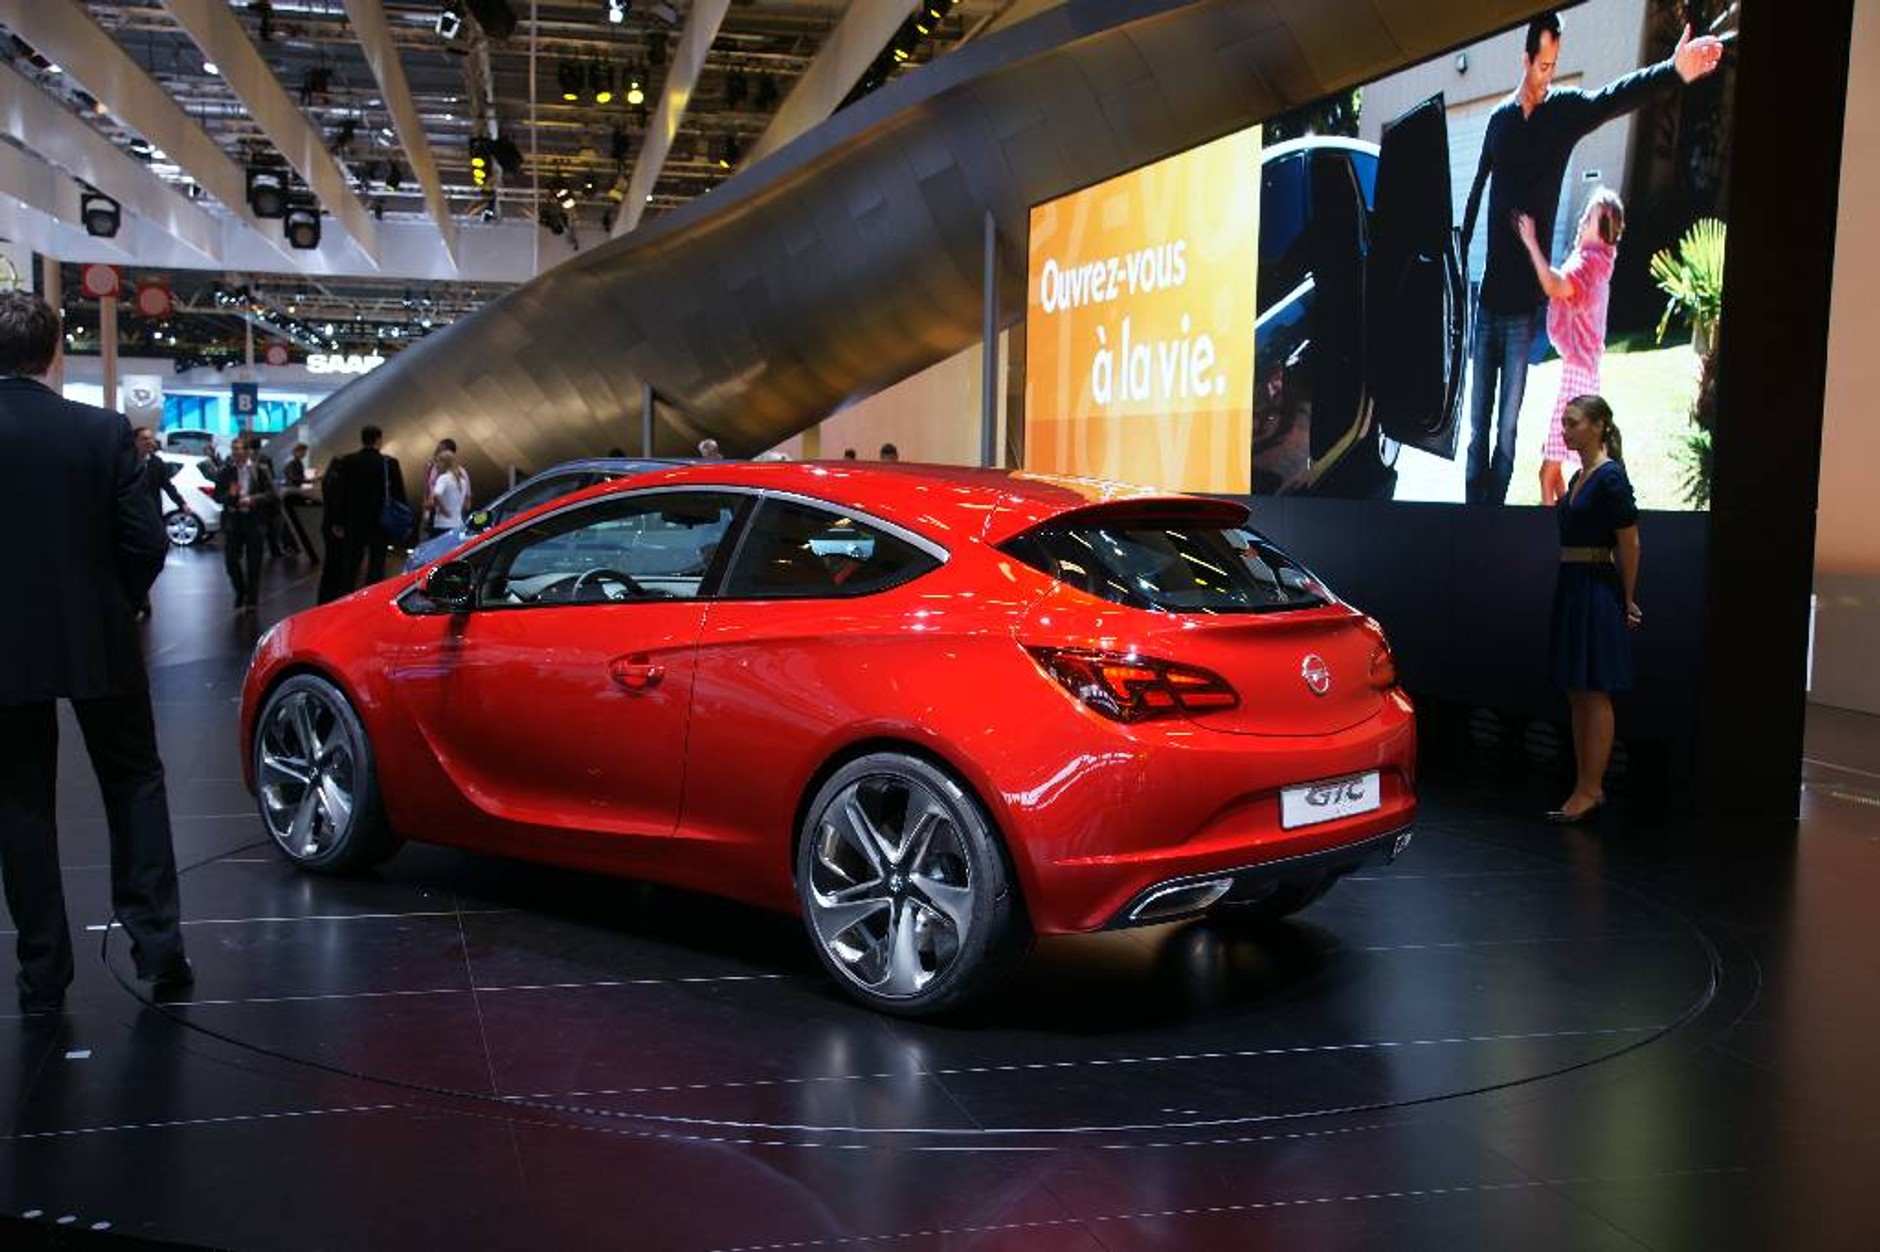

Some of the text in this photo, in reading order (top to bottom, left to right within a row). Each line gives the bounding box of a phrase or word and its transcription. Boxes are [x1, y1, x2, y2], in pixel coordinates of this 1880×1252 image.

[1040, 239, 1188, 314] Ouvrez-vous
[1092, 313, 1226, 405] à la vie.
